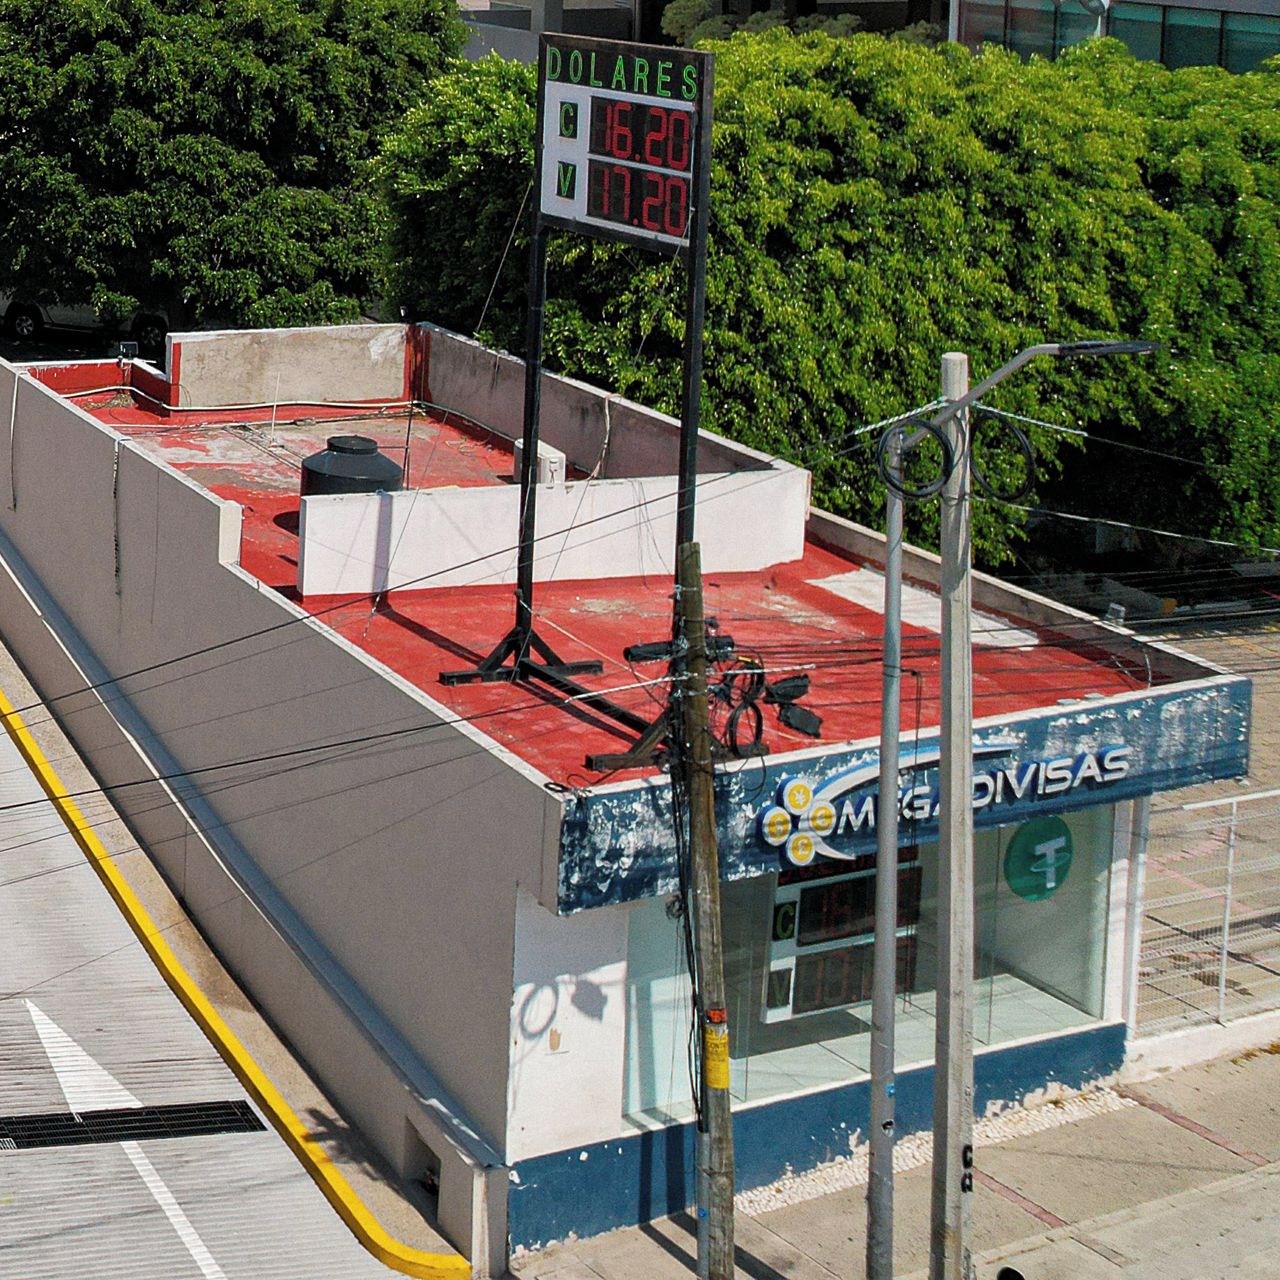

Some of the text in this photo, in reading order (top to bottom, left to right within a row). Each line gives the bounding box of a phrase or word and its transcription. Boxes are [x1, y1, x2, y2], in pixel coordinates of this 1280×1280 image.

[547, 46, 698, 101] DOLARES
[559, 101, 690, 171] C 16.20
[558, 163, 687, 237] V 17.20
